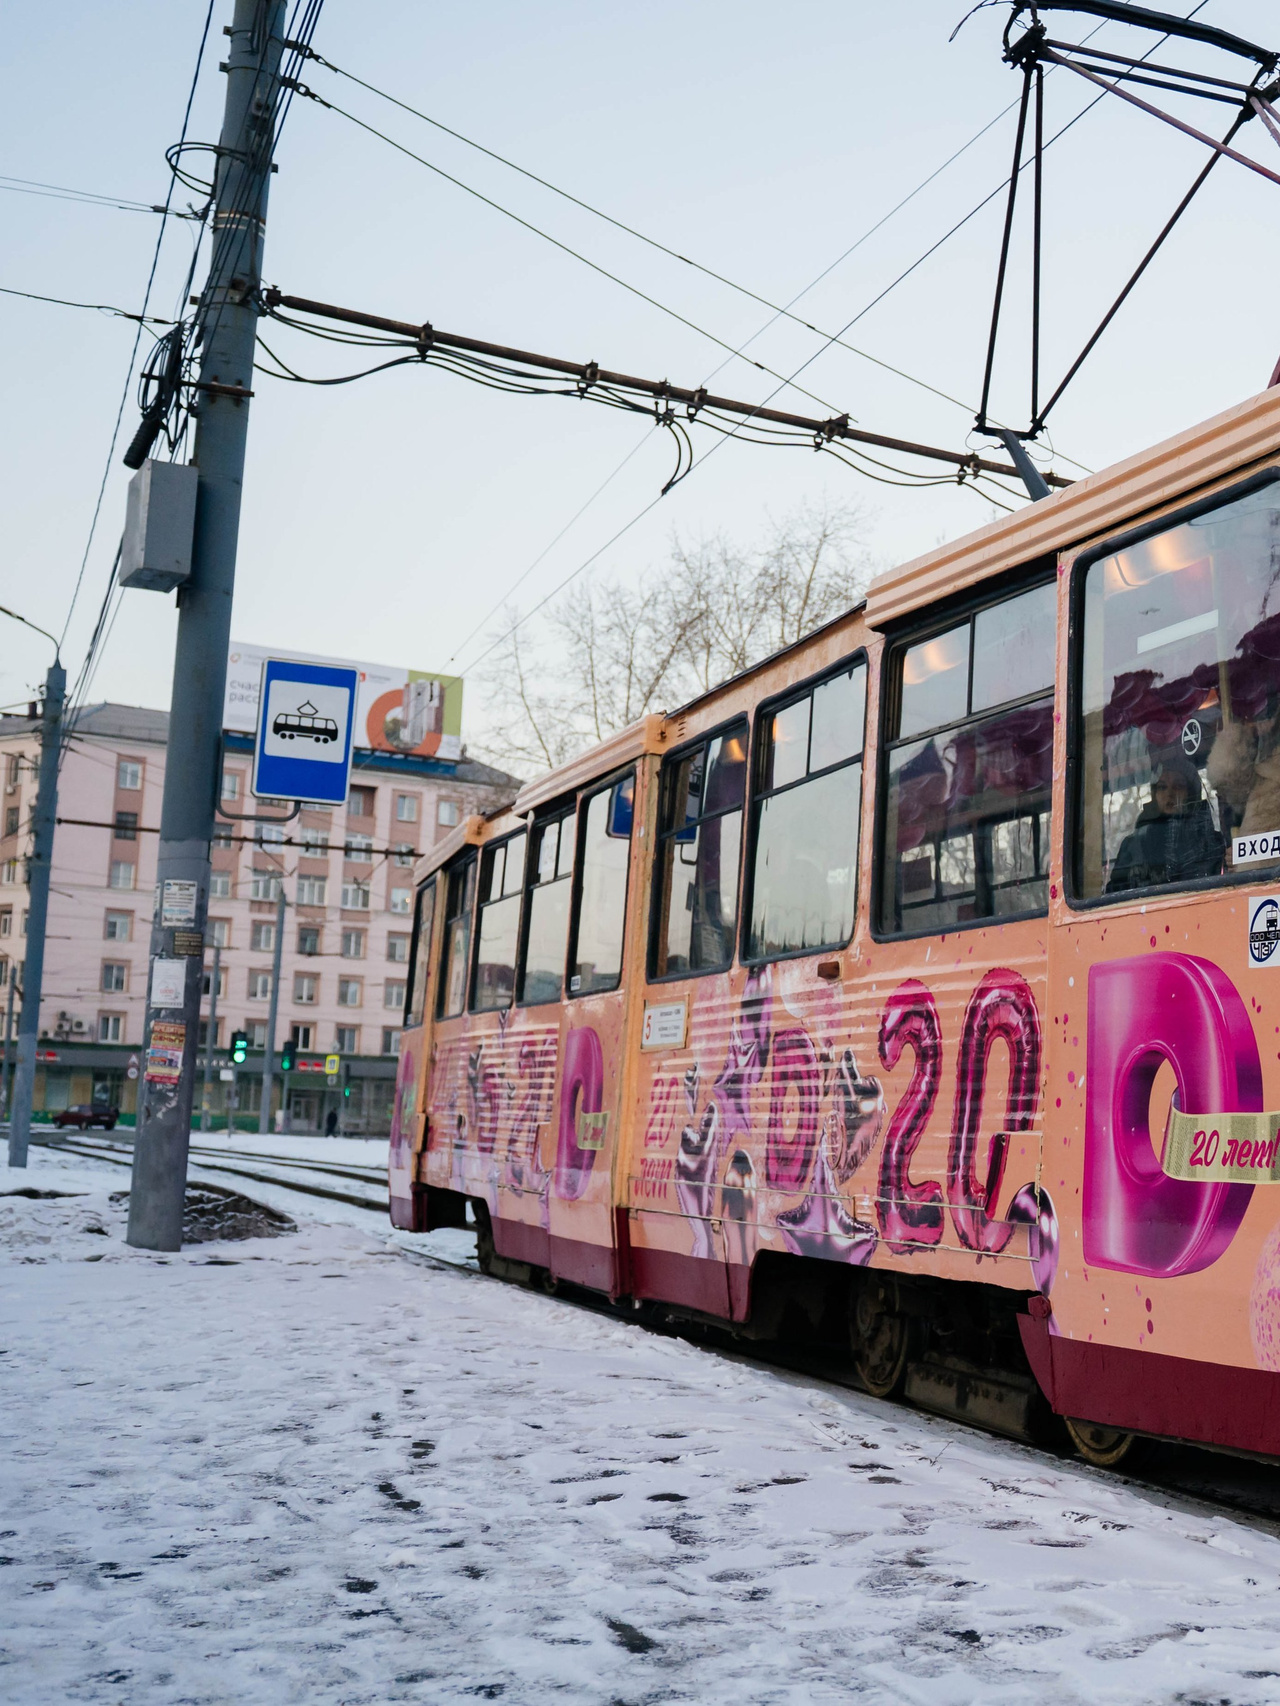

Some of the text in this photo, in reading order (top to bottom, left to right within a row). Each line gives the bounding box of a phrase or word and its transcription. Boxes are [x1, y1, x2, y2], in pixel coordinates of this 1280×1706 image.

[1250, 933, 1265, 942] ООО
[1189, 1128, 1280, 1170] 20 лет!
